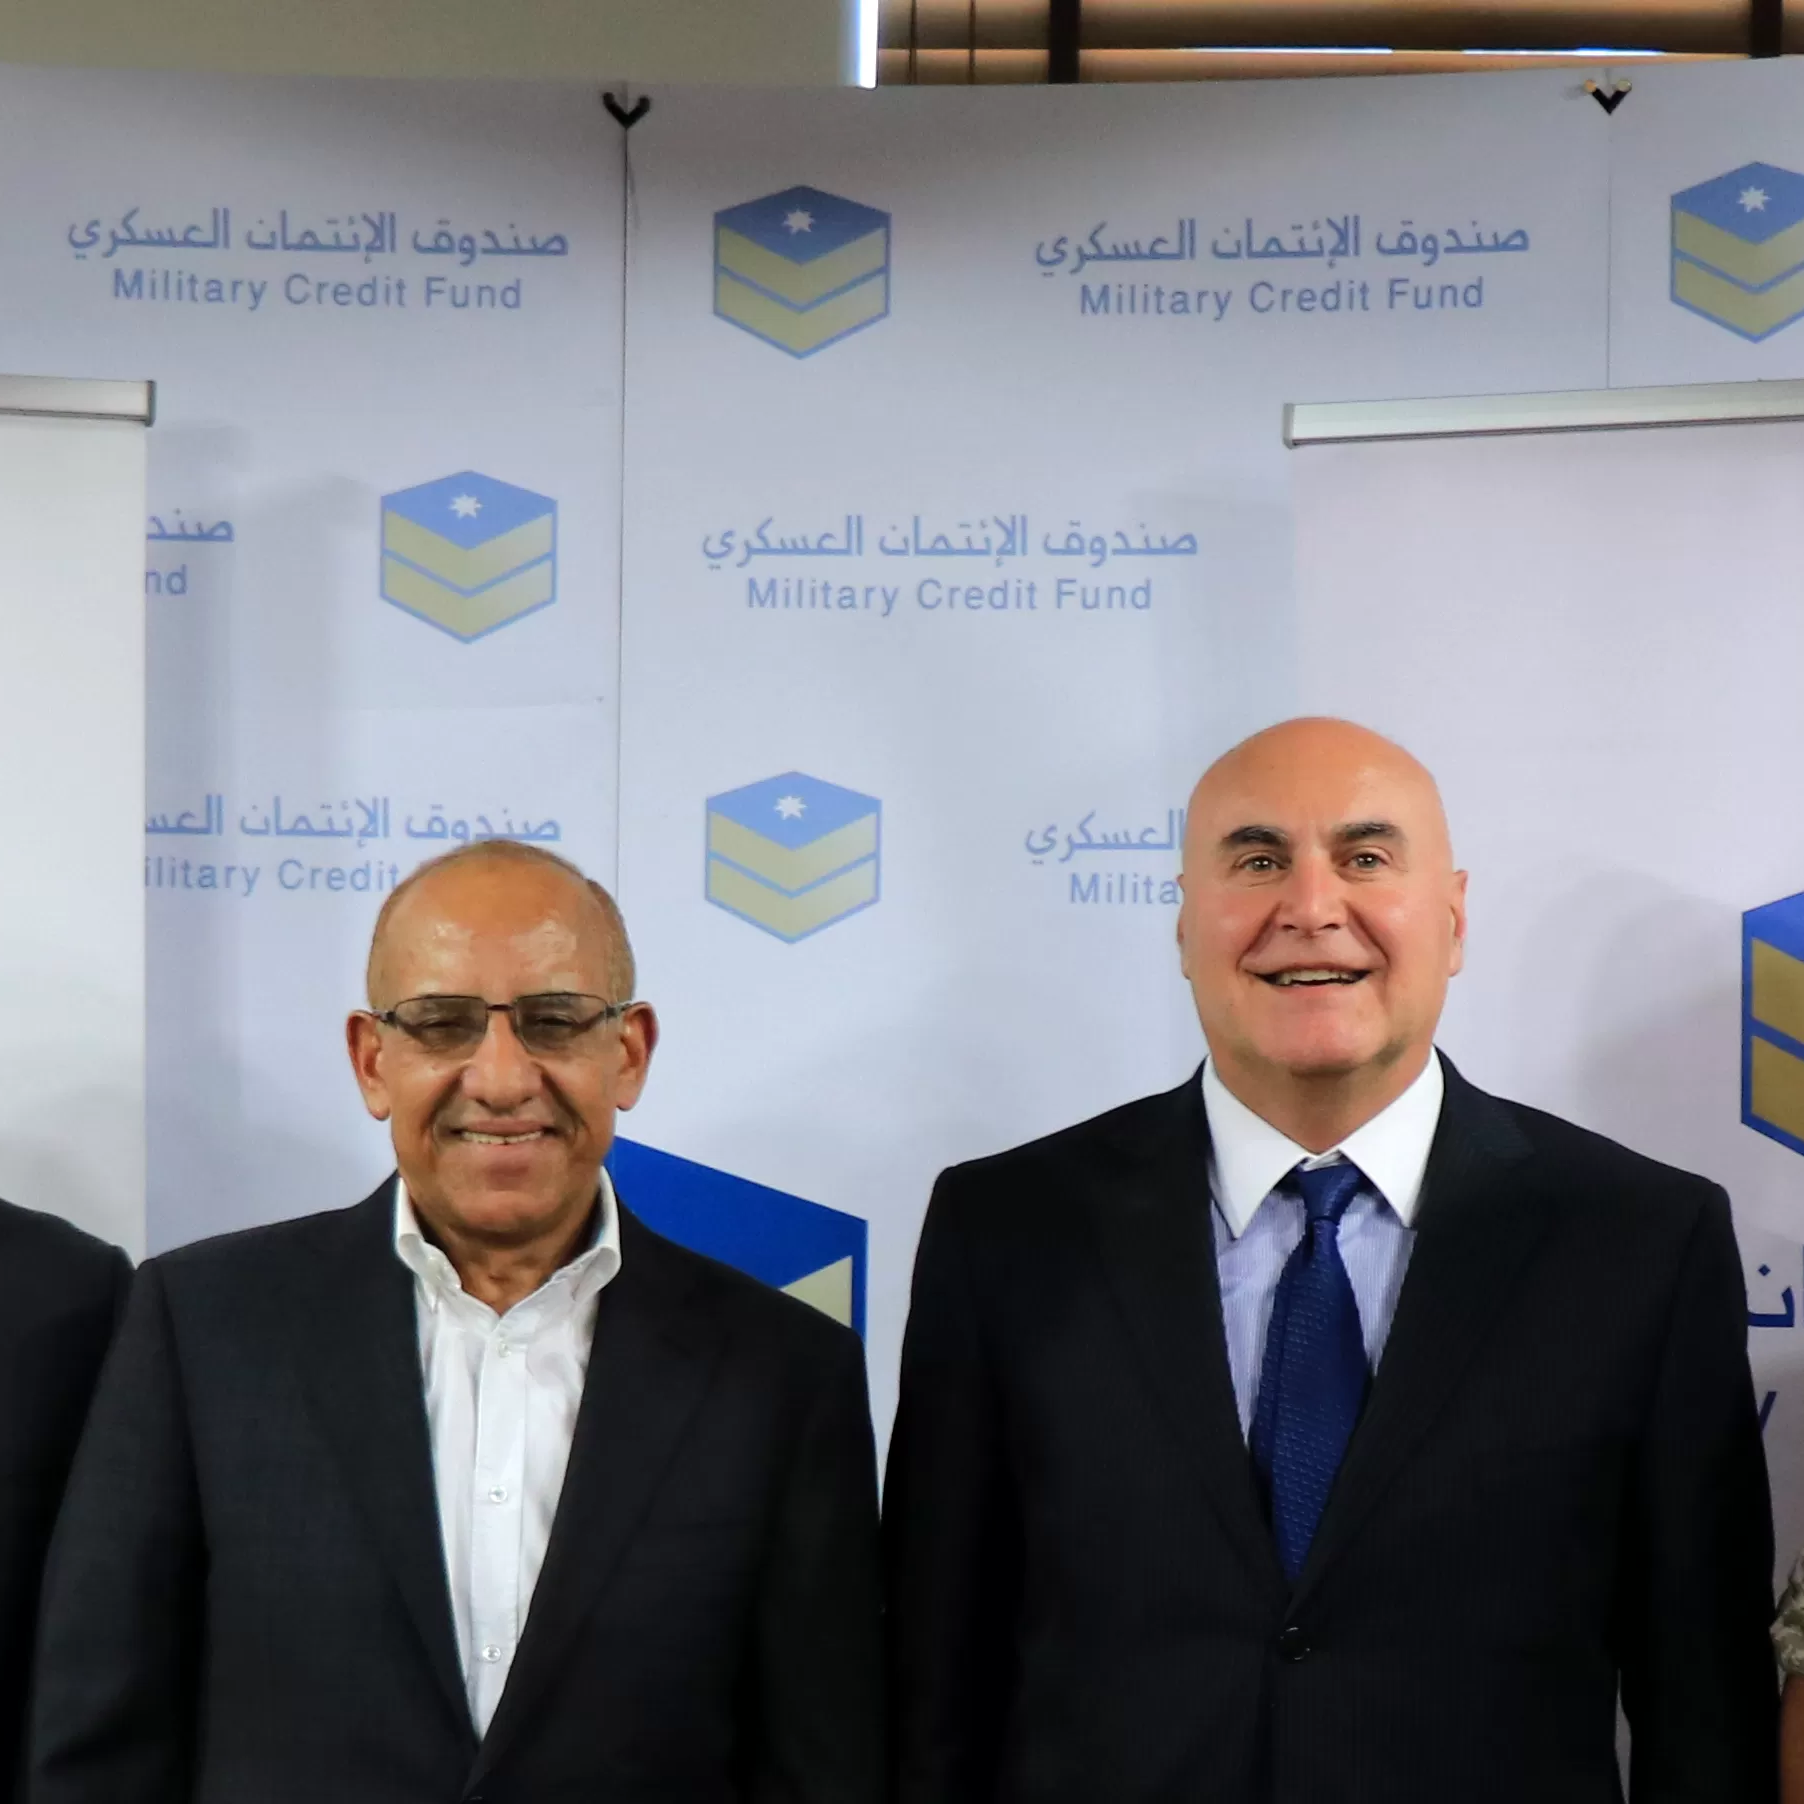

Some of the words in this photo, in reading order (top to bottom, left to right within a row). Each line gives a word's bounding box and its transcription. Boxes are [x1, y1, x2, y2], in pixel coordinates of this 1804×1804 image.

[67, 206, 229, 259] العسكري
[411, 220, 569, 265] صندوق
[1034, 218, 1195, 276] العسكري
[1376, 220, 1529, 266] صندوق
[113, 268, 266, 310] Military
[284, 274, 406, 308] Credit
[426, 277, 522, 309] Fund
[1080, 283, 1232, 322] Military
[1249, 279, 1370, 313] Credit
[1388, 276, 1484, 309] Fund
[146, 507, 235, 543] صند
[702, 515, 863, 571] العسكري
[1042, 519, 1198, 567] صندوق
[145, 563, 188, 596] nd
[747, 577, 900, 618] Military
[916, 578, 1038, 610] Credit
[1055, 578, 1152, 610] Fund
[145, 793, 224, 836] العس
[405, 803, 562, 846] صندوق
[1025, 807, 1186, 866] العسكري
[145, 855, 261, 897] ilitary
[278, 857, 400, 892] Credit
[1069, 872, 1180, 905] Milita
